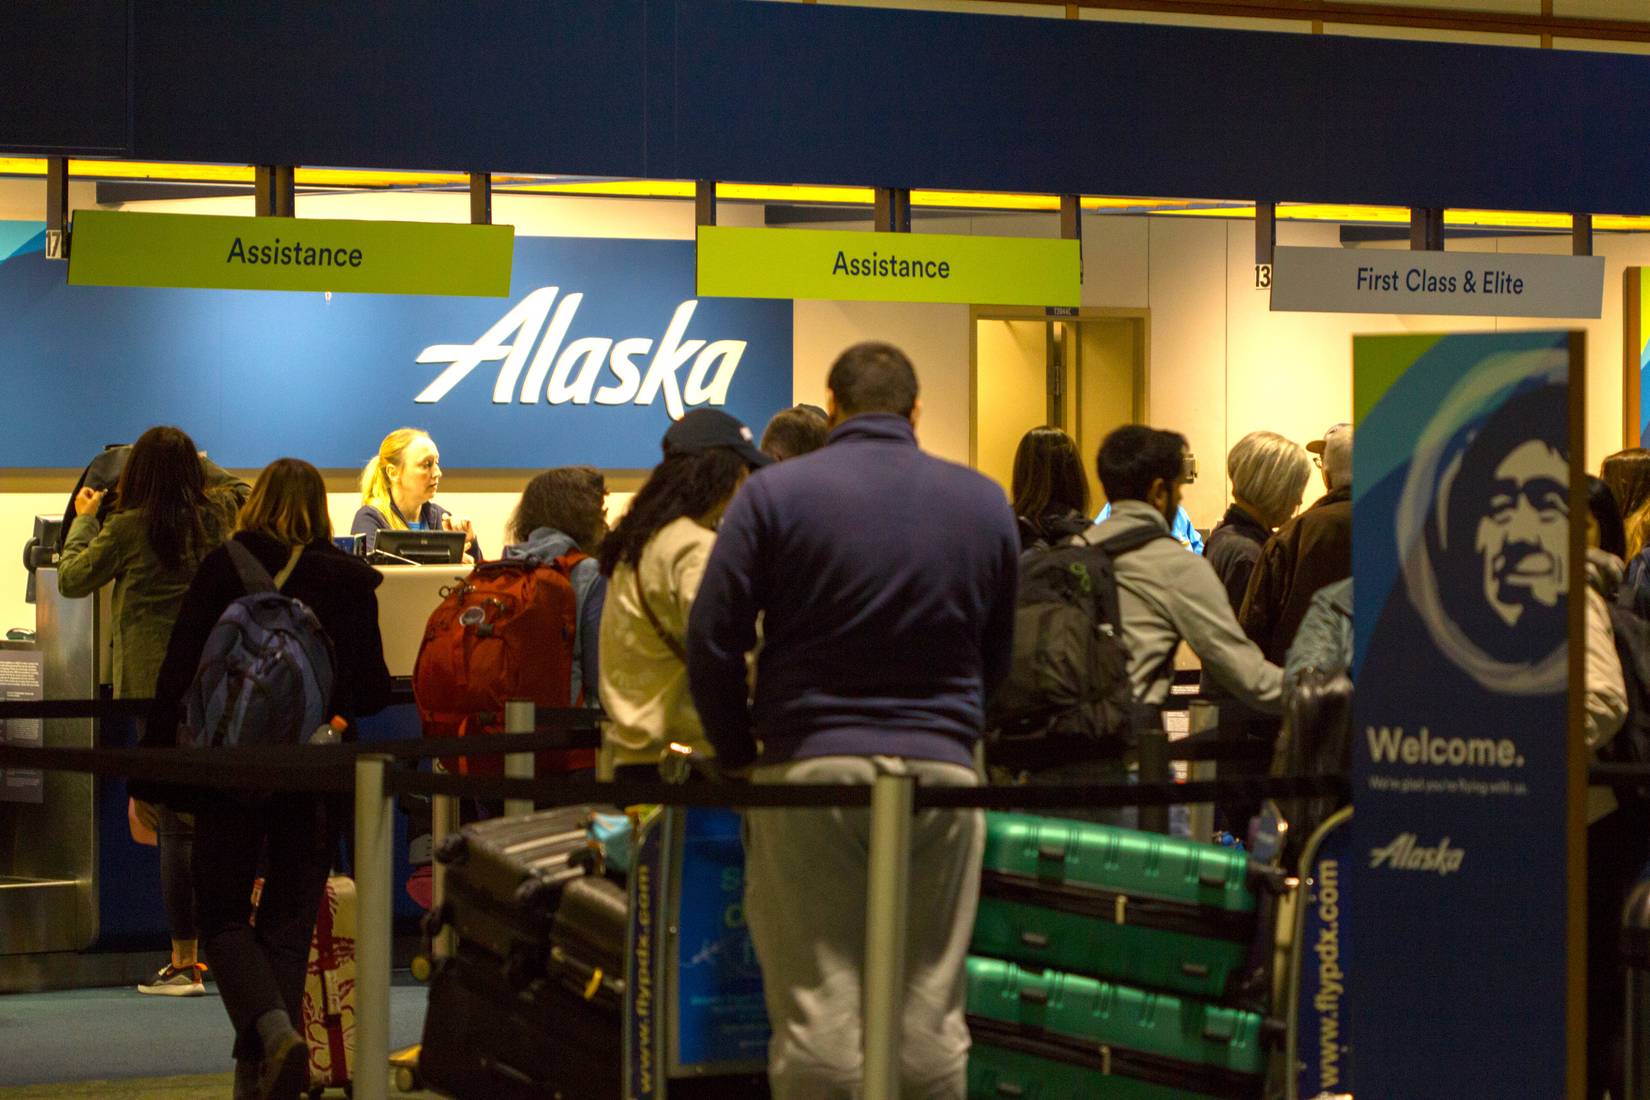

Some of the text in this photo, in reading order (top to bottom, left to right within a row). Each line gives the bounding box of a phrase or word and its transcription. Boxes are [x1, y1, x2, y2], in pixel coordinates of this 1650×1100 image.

[46, 231, 61, 257] 17
[226, 236, 363, 268] Assistance
[832, 250, 950, 279] Assistance
[1255, 265, 1271, 288] 13
[1356, 267, 1524, 295] First Class & Elite
[414, 286, 747, 421] Alaska
[1366, 726, 1526, 768] Welcome.
[1369, 832, 1465, 876] Alaska
[637, 865, 651, 1092] www.flypdx.com
[1314, 859, 1343, 1088] www.flypdx.com
